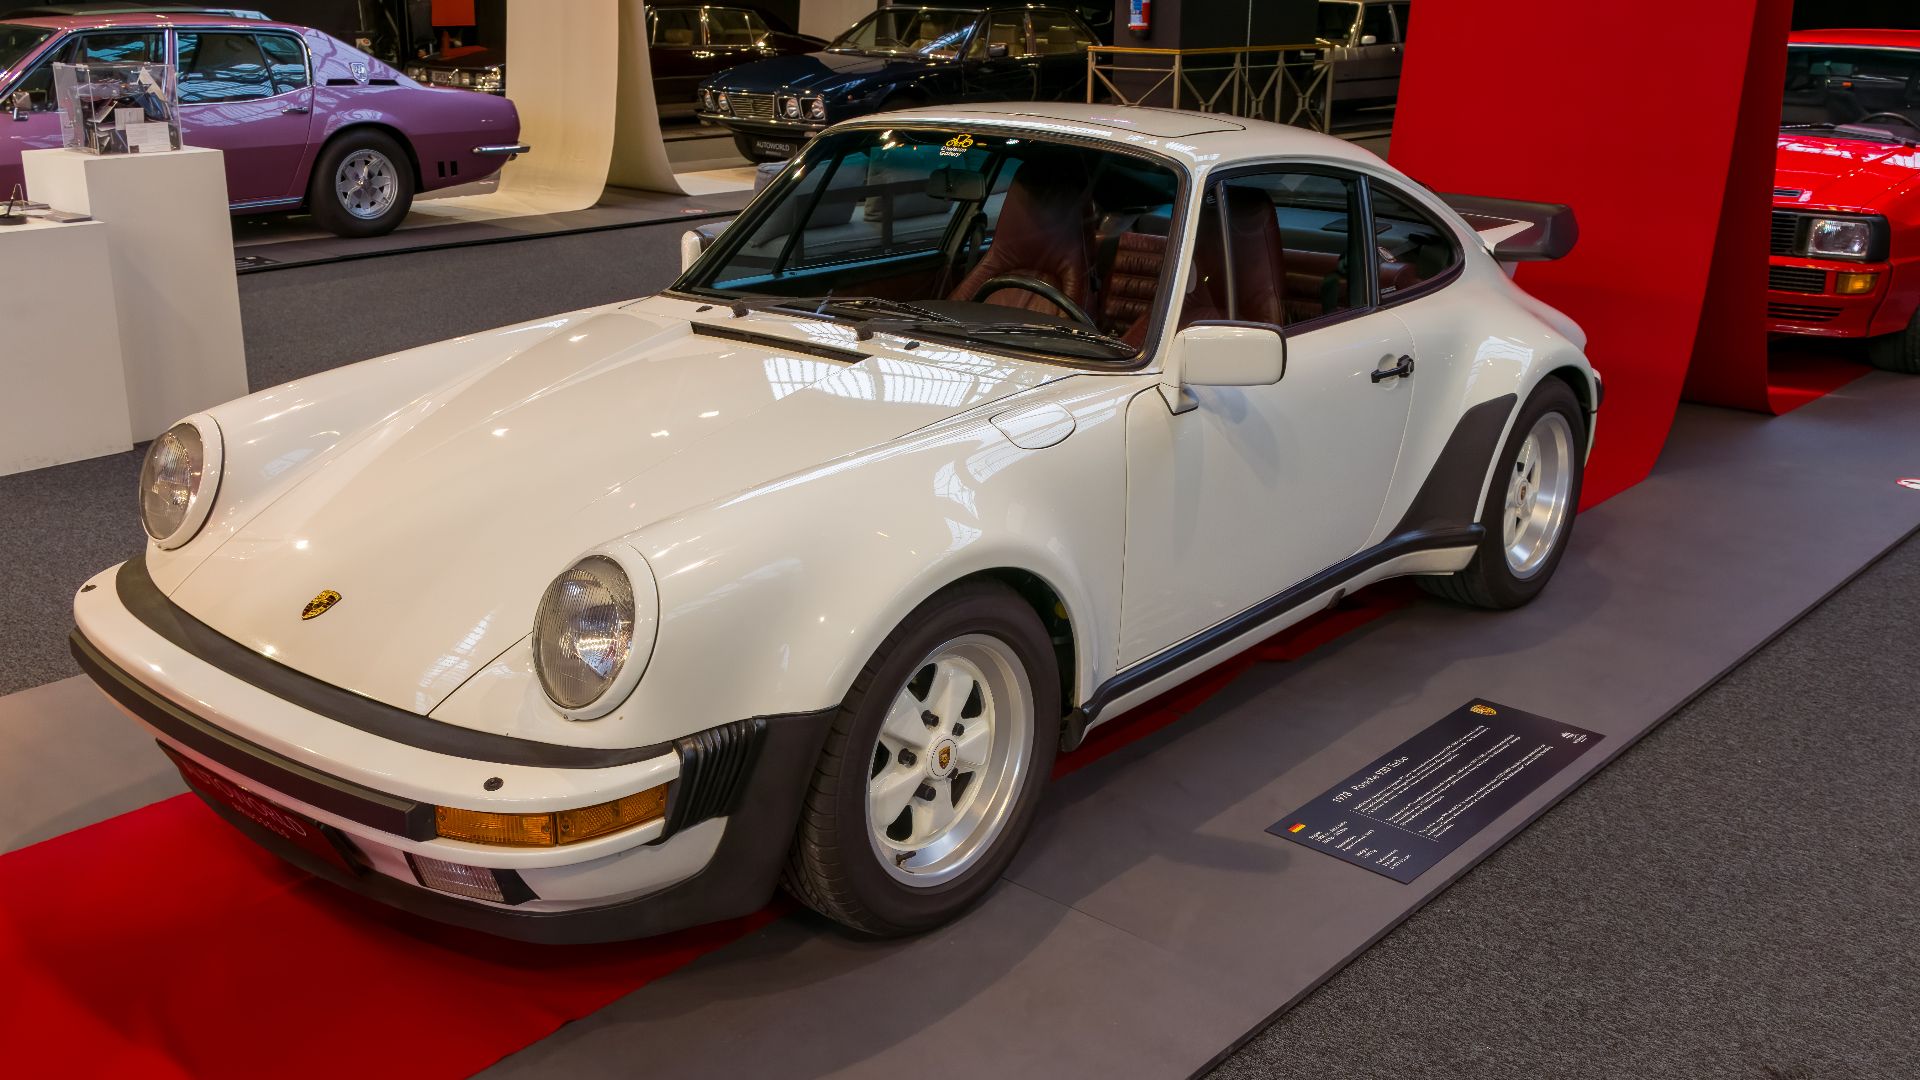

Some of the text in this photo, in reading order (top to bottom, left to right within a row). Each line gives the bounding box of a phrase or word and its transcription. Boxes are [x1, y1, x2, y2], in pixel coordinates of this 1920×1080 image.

[756, 141, 790, 152] AUTOWORLD
[1332, 791, 1353, 803] 1978
[1351, 774, 1380, 791] Porsche
